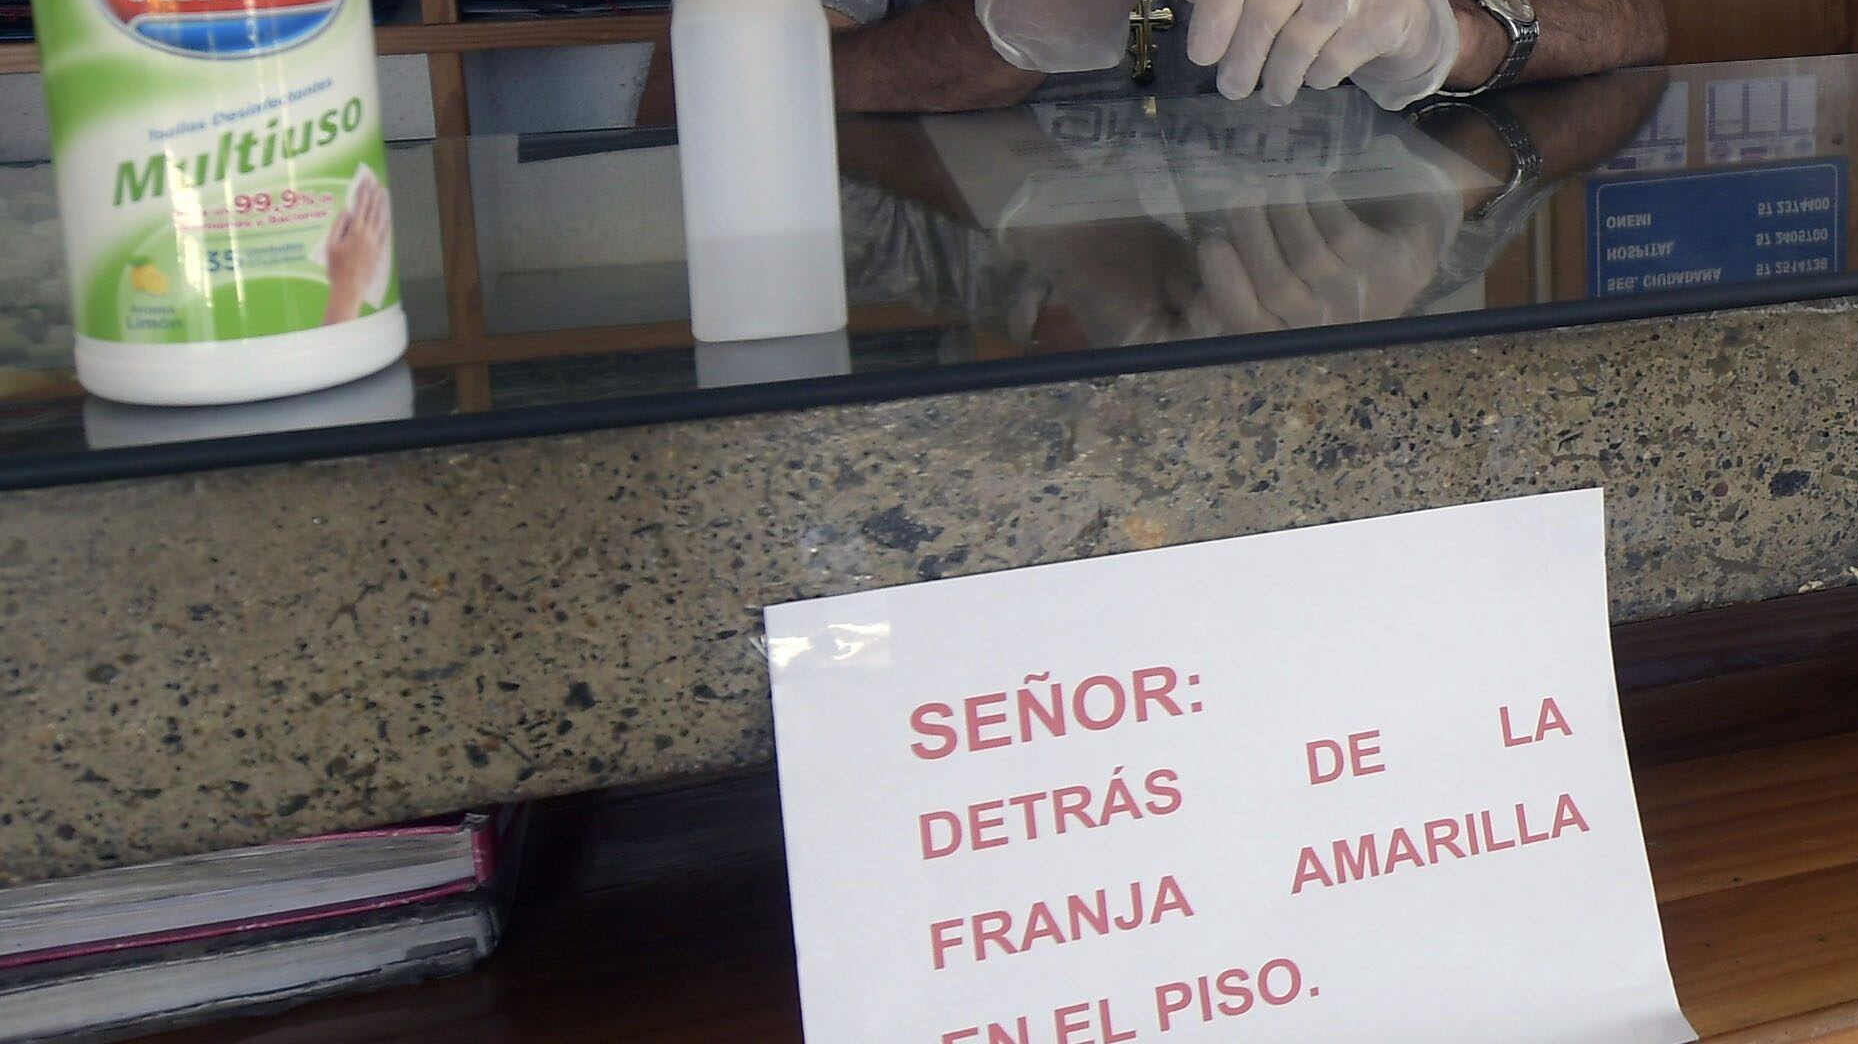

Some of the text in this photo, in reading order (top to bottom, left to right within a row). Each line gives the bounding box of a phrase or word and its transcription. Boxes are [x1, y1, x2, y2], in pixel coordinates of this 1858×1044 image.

[113, 96, 362, 206] Multiuso
[908, 662, 1206, 762] SEÑOR:
[917, 697, 1574, 861] DETRÁS DE LA
[929, 792, 1590, 971] FRANJA AMARILLA
[1054, 998, 1137, 1044] EL
[1156, 957, 1321, 1032] PISO.
